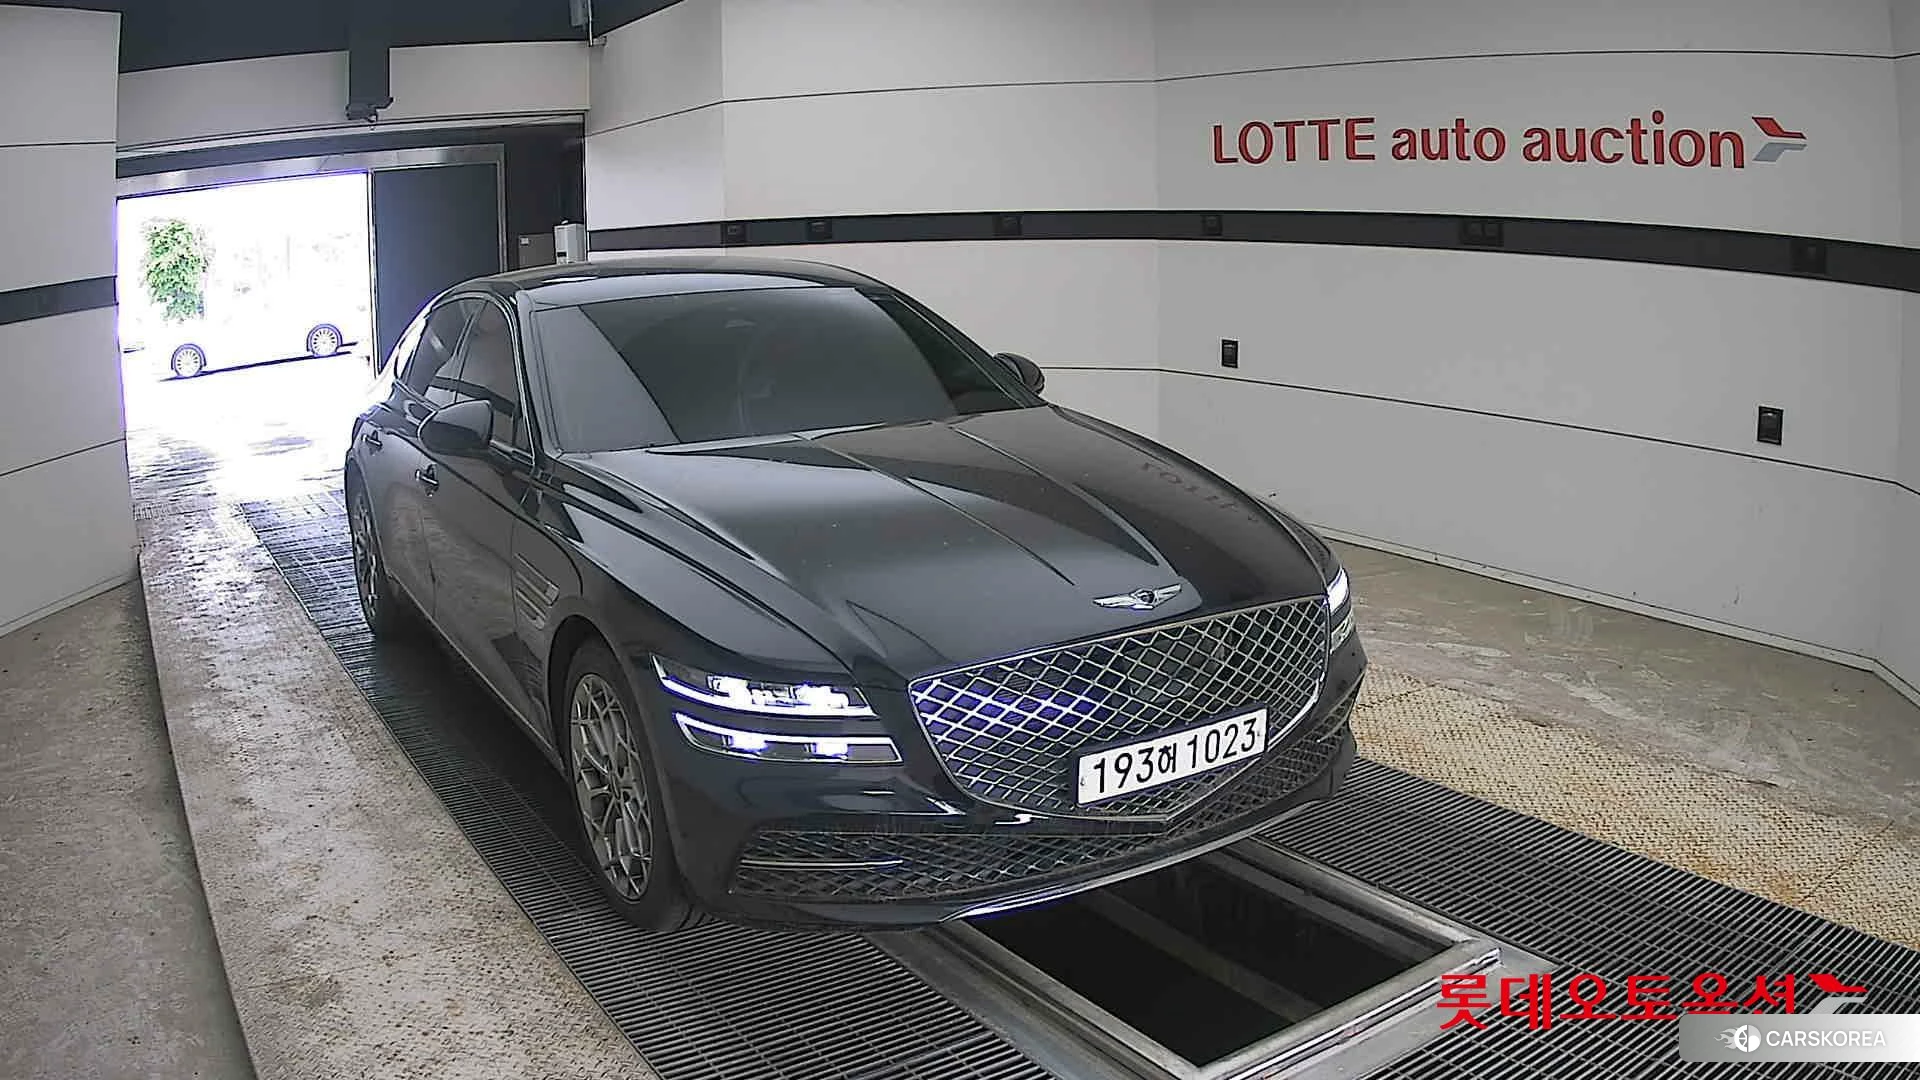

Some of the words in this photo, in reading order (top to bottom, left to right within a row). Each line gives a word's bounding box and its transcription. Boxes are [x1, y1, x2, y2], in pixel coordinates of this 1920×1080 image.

[1213, 117, 1376, 164] LOTTE
[1391, 117, 1507, 162] auto
[1522, 110, 1746, 169] auction
[1093, 742, 1177, 793] 193허
[1187, 717, 1258, 769] 1023
